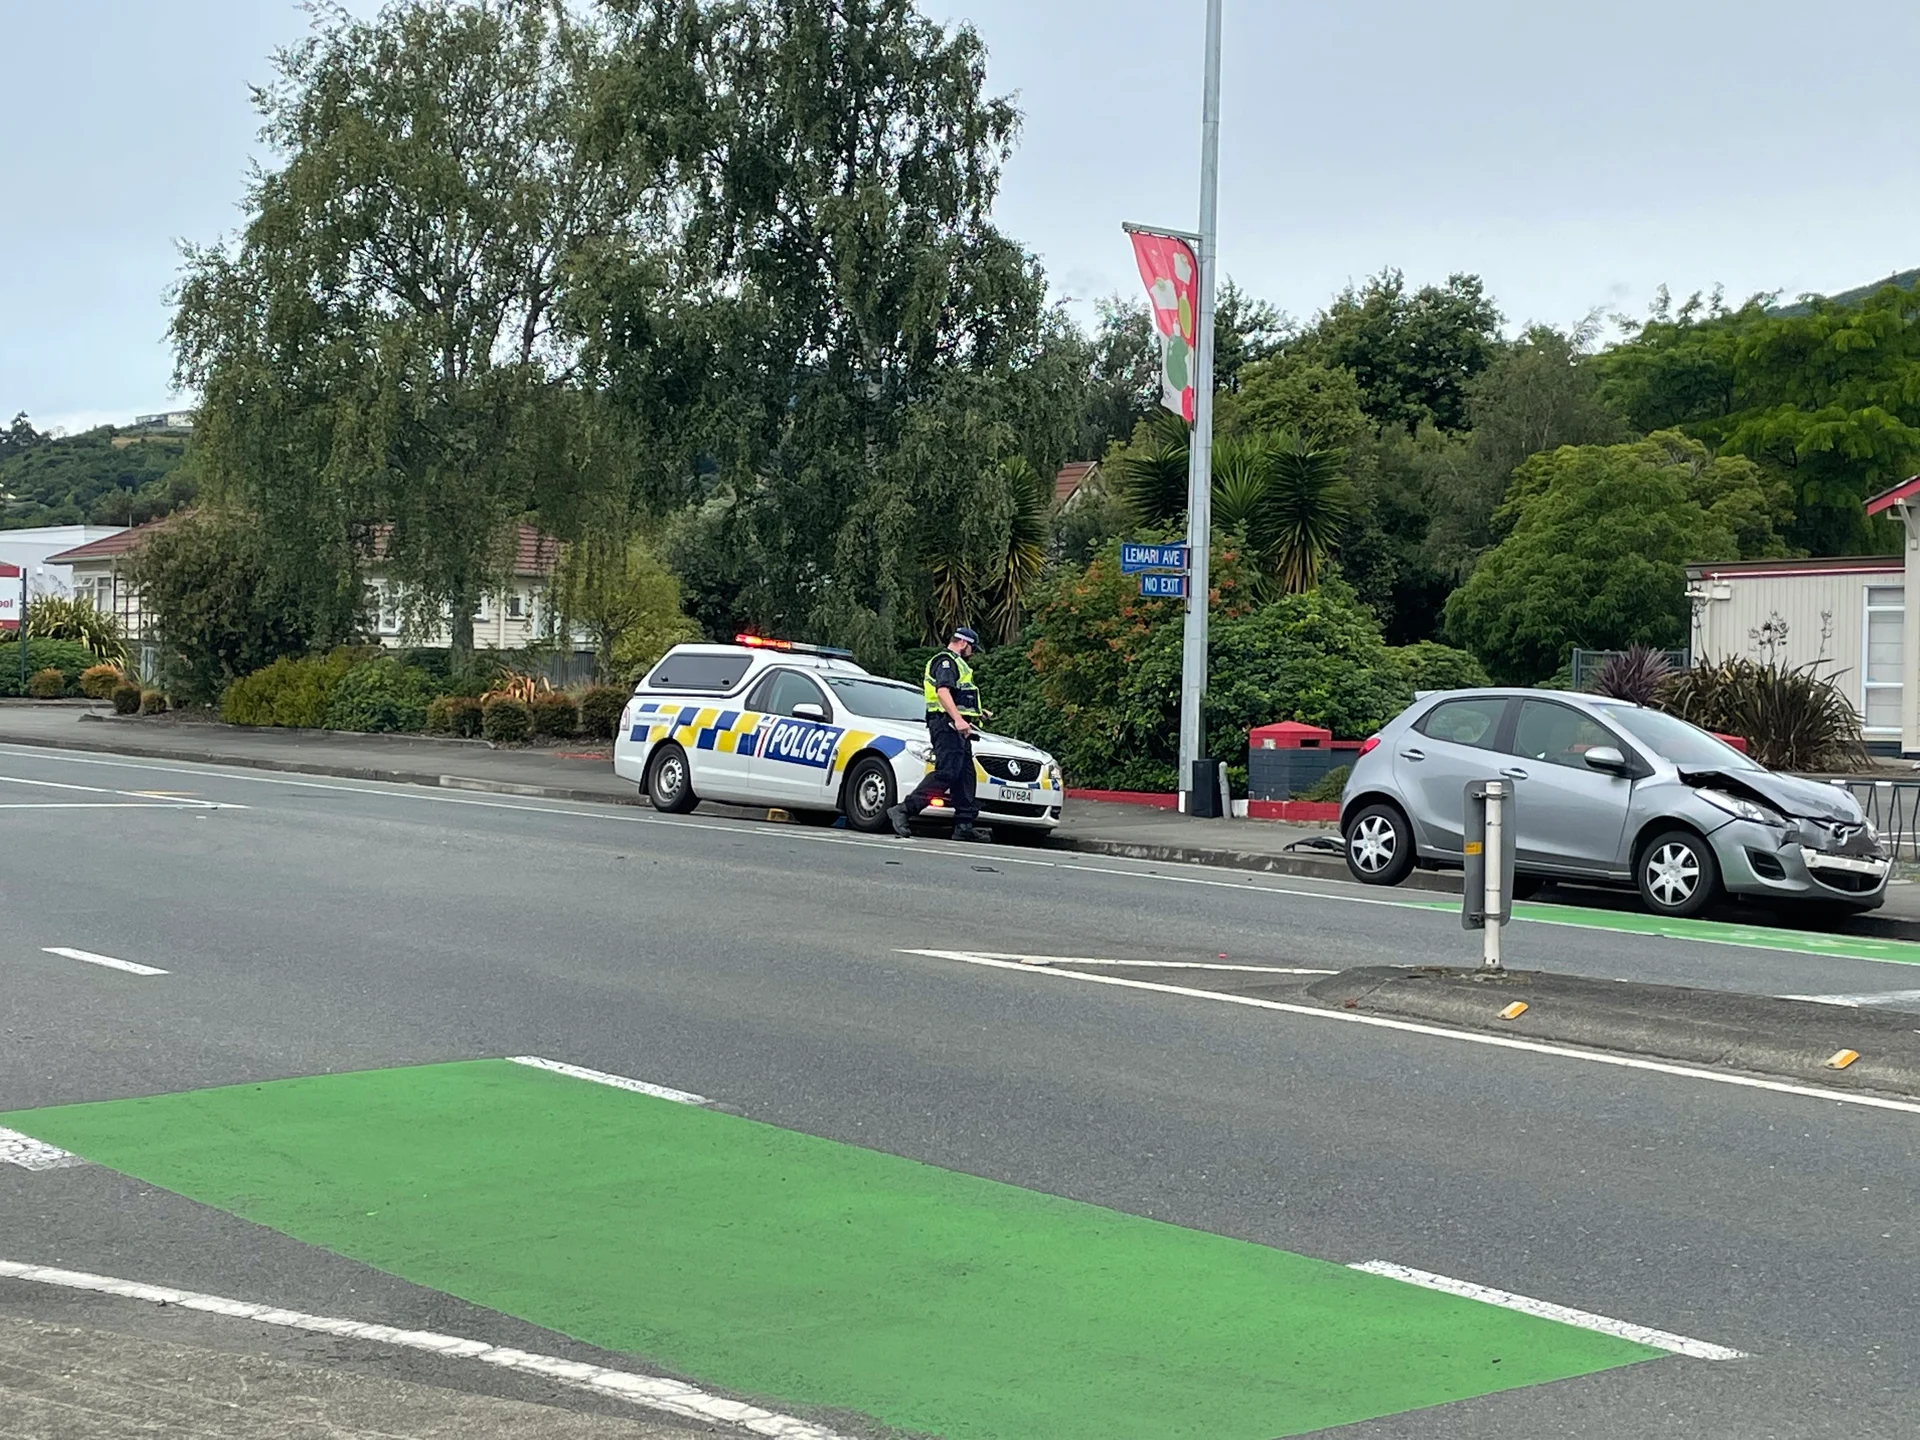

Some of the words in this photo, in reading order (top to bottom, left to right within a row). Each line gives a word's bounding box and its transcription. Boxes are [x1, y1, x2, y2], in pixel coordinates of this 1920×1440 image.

[1125, 547, 1159, 564] LEMARI
[1162, 550, 1180, 565] AVE
[1145, 577, 1158, 592] NO
[1161, 578, 1180, 593] EXIT
[769, 723, 837, 762] POLICE
